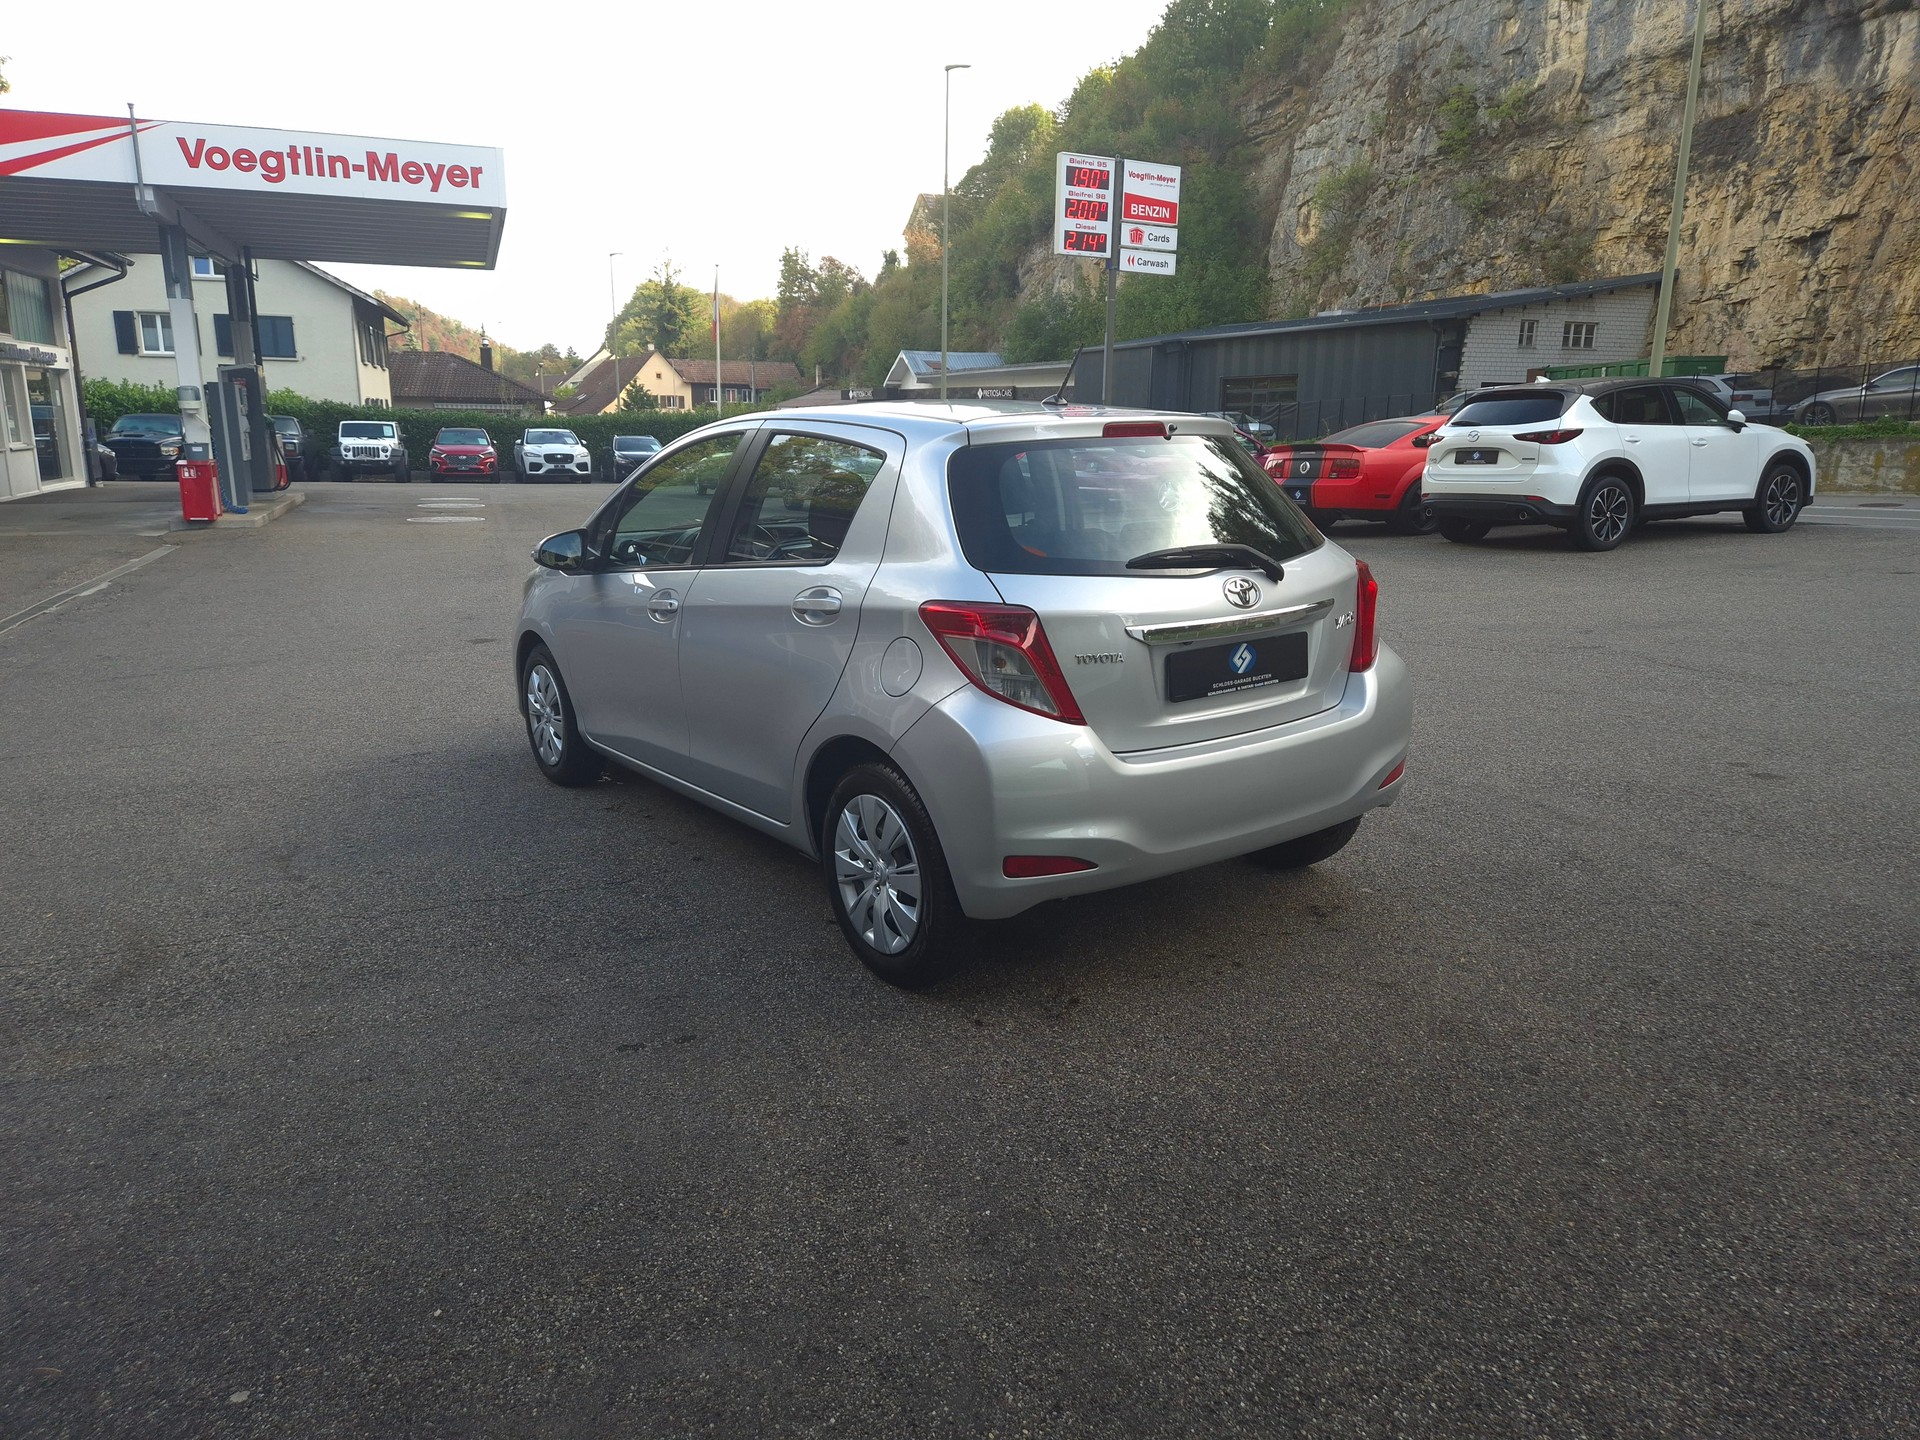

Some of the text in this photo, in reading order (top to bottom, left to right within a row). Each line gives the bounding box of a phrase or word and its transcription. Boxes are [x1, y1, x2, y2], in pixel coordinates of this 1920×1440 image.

[176, 137, 483, 192] Voegtlin-Meyer
[1069, 158, 1095, 166] Bleifrei
[1128, 170, 1177, 184] Voegtlin-Meyer
[1068, 190, 1094, 198] Bleifrei
[1130, 203, 1170, 219] BENZIN
[1147, 232, 1171, 243] Cards
[1136, 257, 1169, 269] Carwash
[1074, 652, 1125, 664] TOYOTA
[1213, 677, 1251, 688] SCHLOSS-GARAGE
